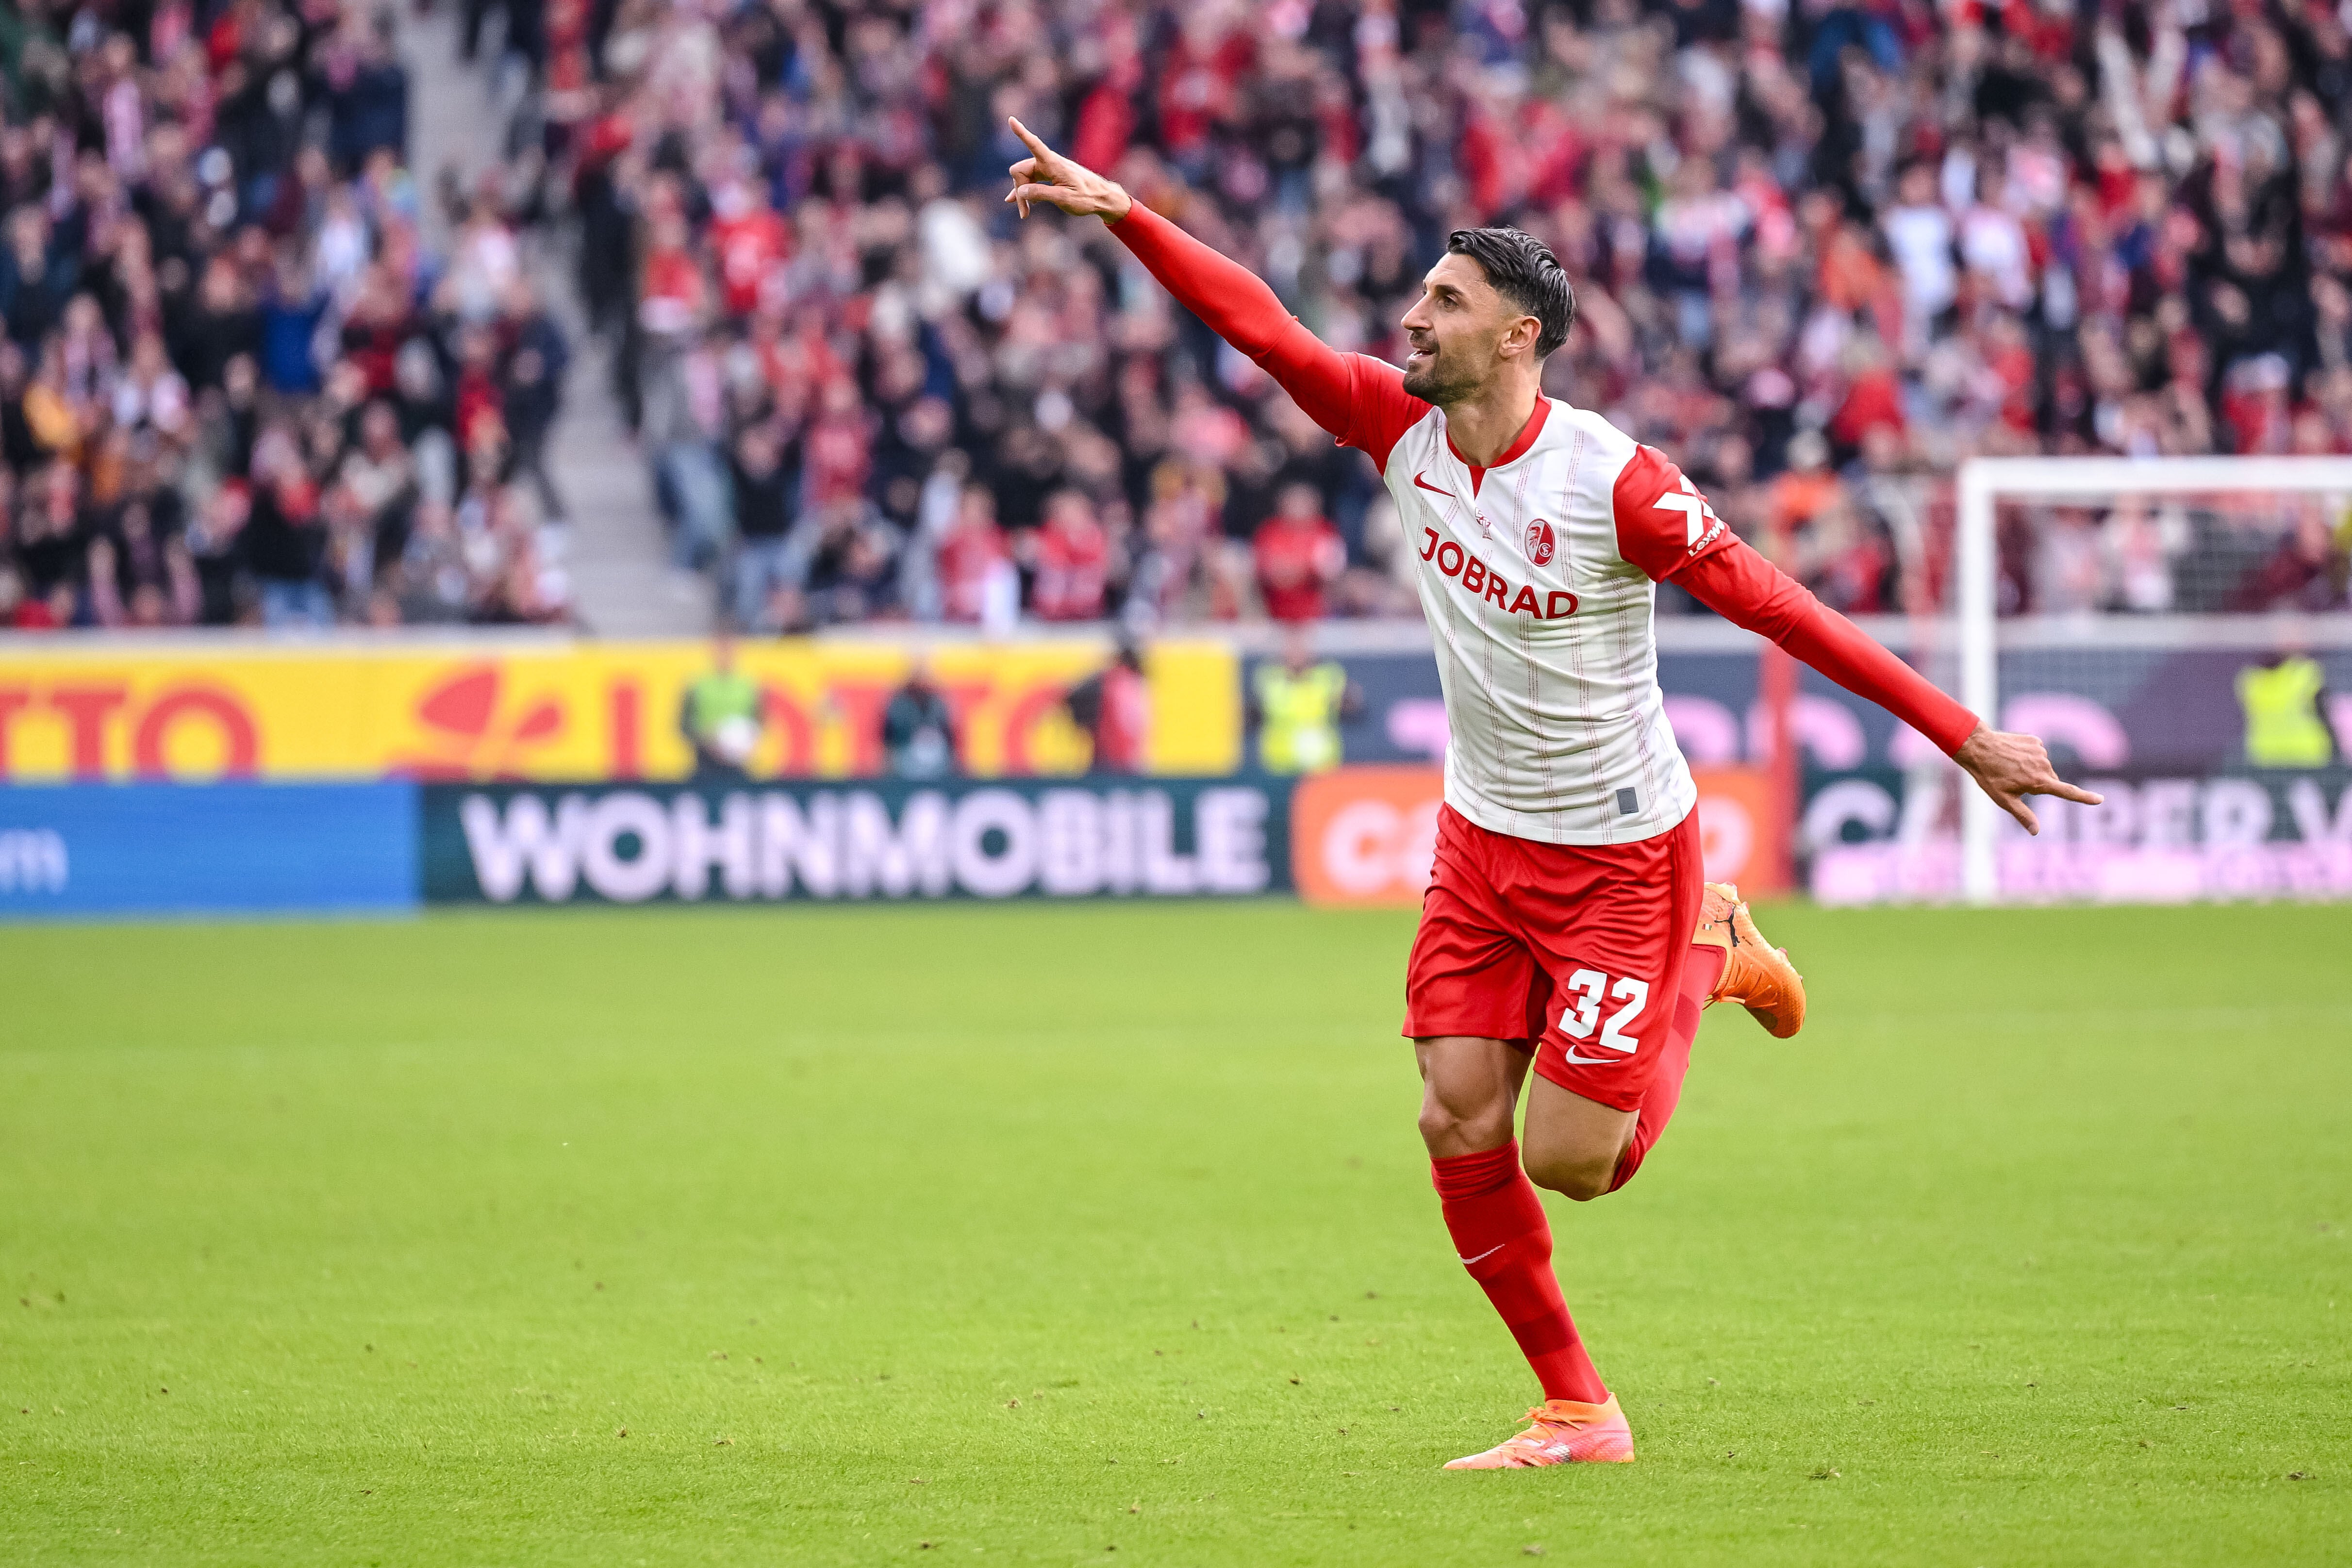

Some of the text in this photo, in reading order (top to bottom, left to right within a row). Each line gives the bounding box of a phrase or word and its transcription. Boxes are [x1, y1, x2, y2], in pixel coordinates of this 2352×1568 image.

[1418, 526, 1579, 620] JOBRAD
[458, 789, 1270, 901] WOHNMOBILE
[1558, 968, 1649, 1054] 32
